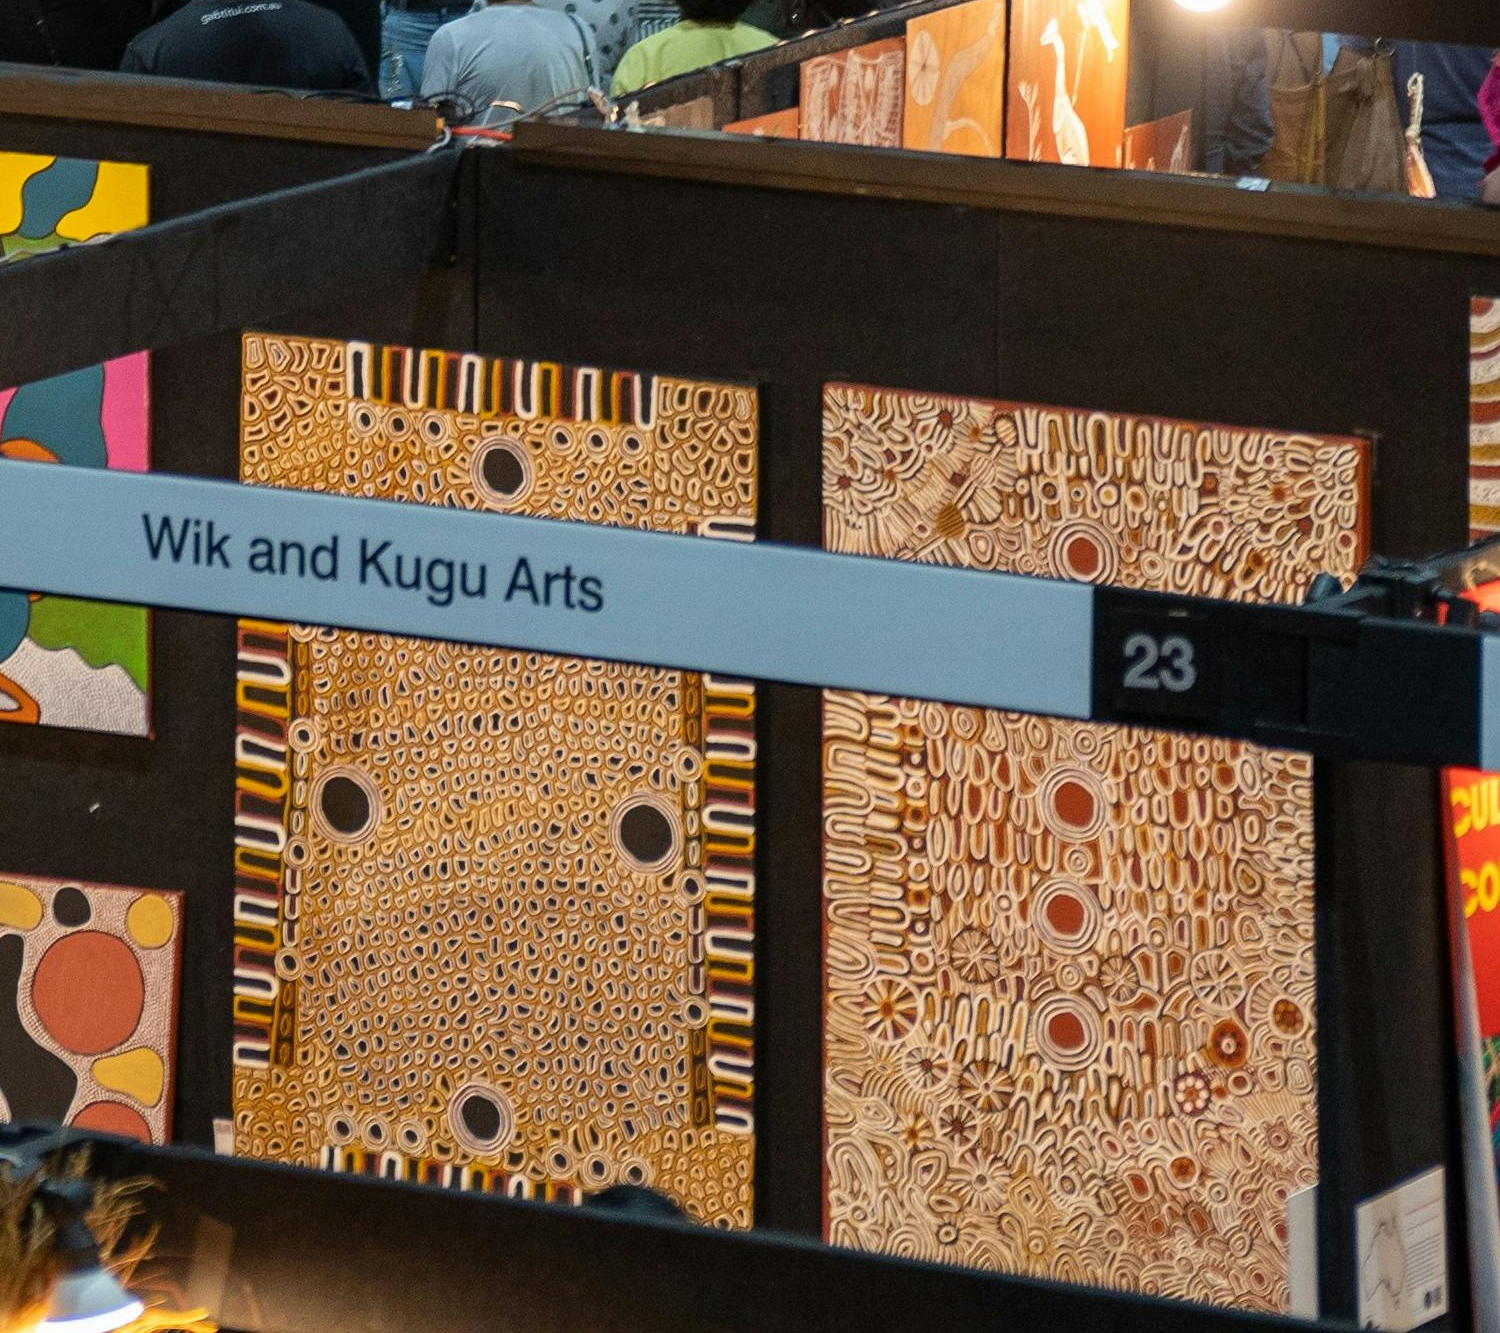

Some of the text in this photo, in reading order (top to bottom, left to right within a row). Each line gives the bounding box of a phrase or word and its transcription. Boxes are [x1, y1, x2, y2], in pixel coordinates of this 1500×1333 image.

[142, 513, 604, 613] Wik and Kugu Arts
[1123, 633, 1197, 692] 23
